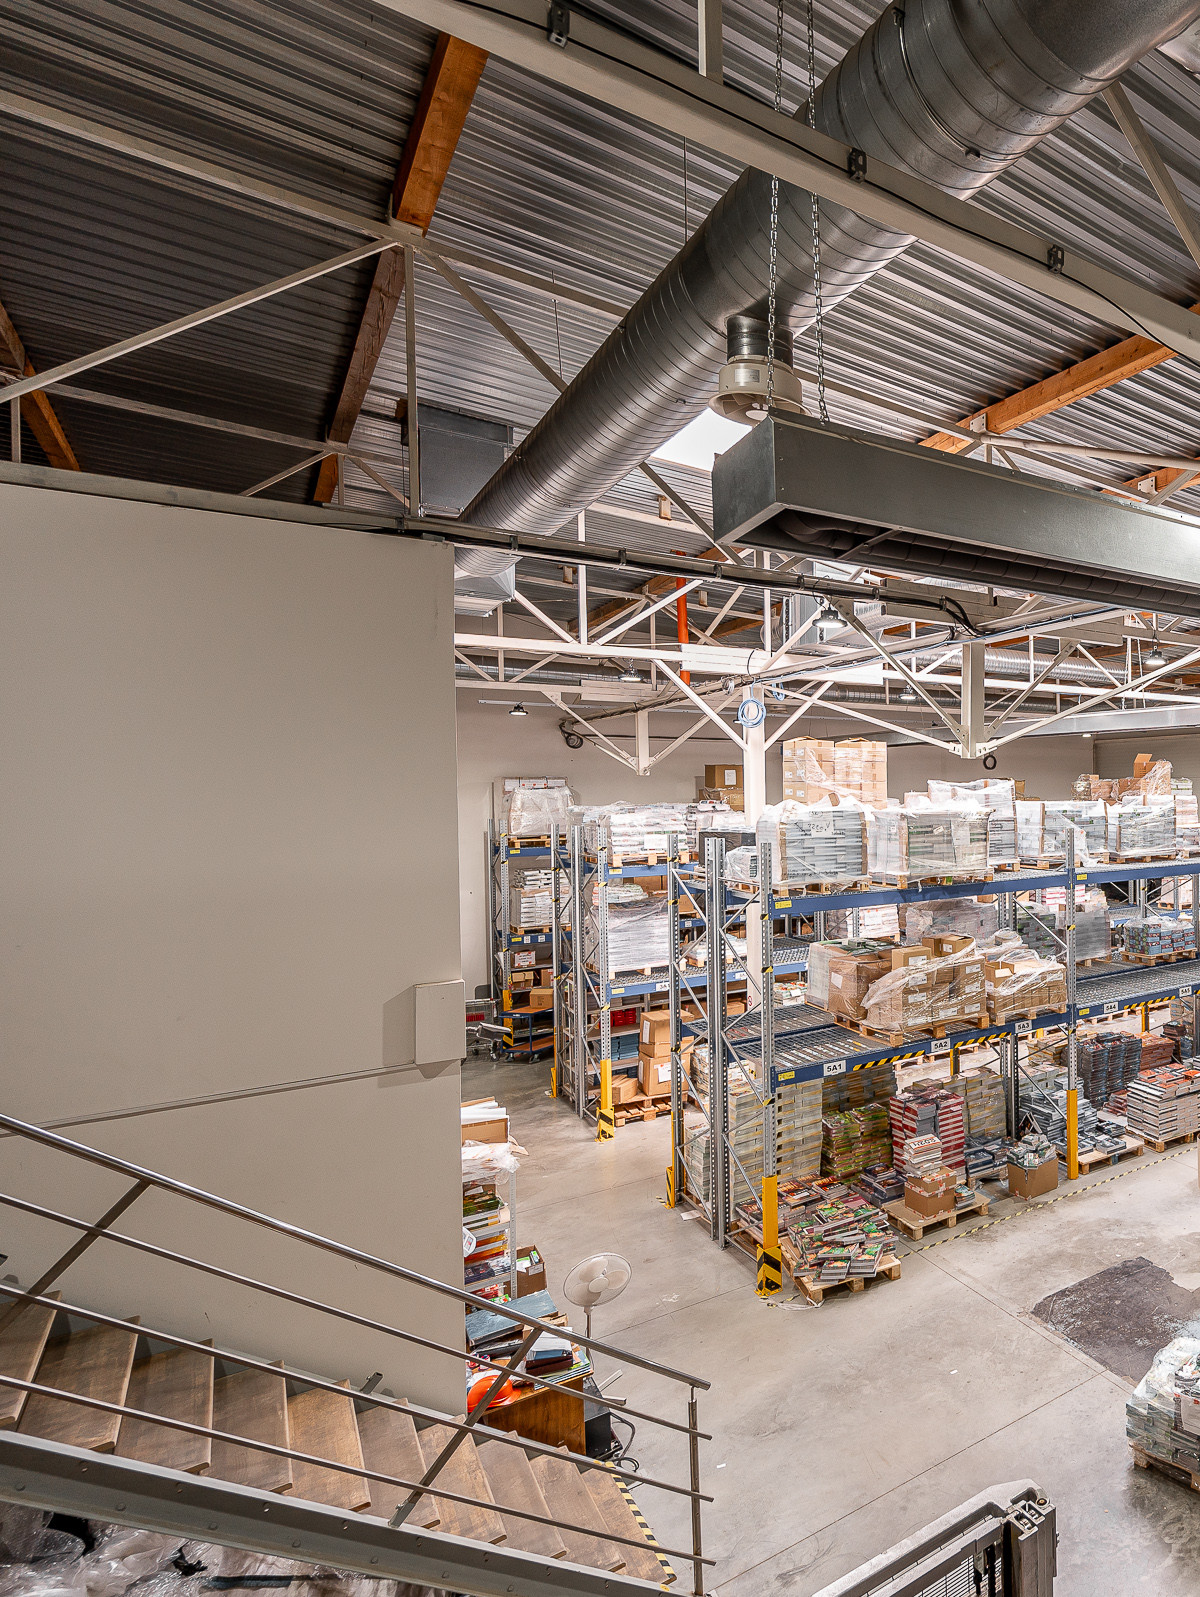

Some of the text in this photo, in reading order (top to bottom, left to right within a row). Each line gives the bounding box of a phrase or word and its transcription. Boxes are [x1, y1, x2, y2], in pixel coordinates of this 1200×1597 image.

[1017, 1022, 1030, 1031] 5A3
[934, 1041, 948, 1050] 5A2
[827, 1063, 842, 1073] 5A1
